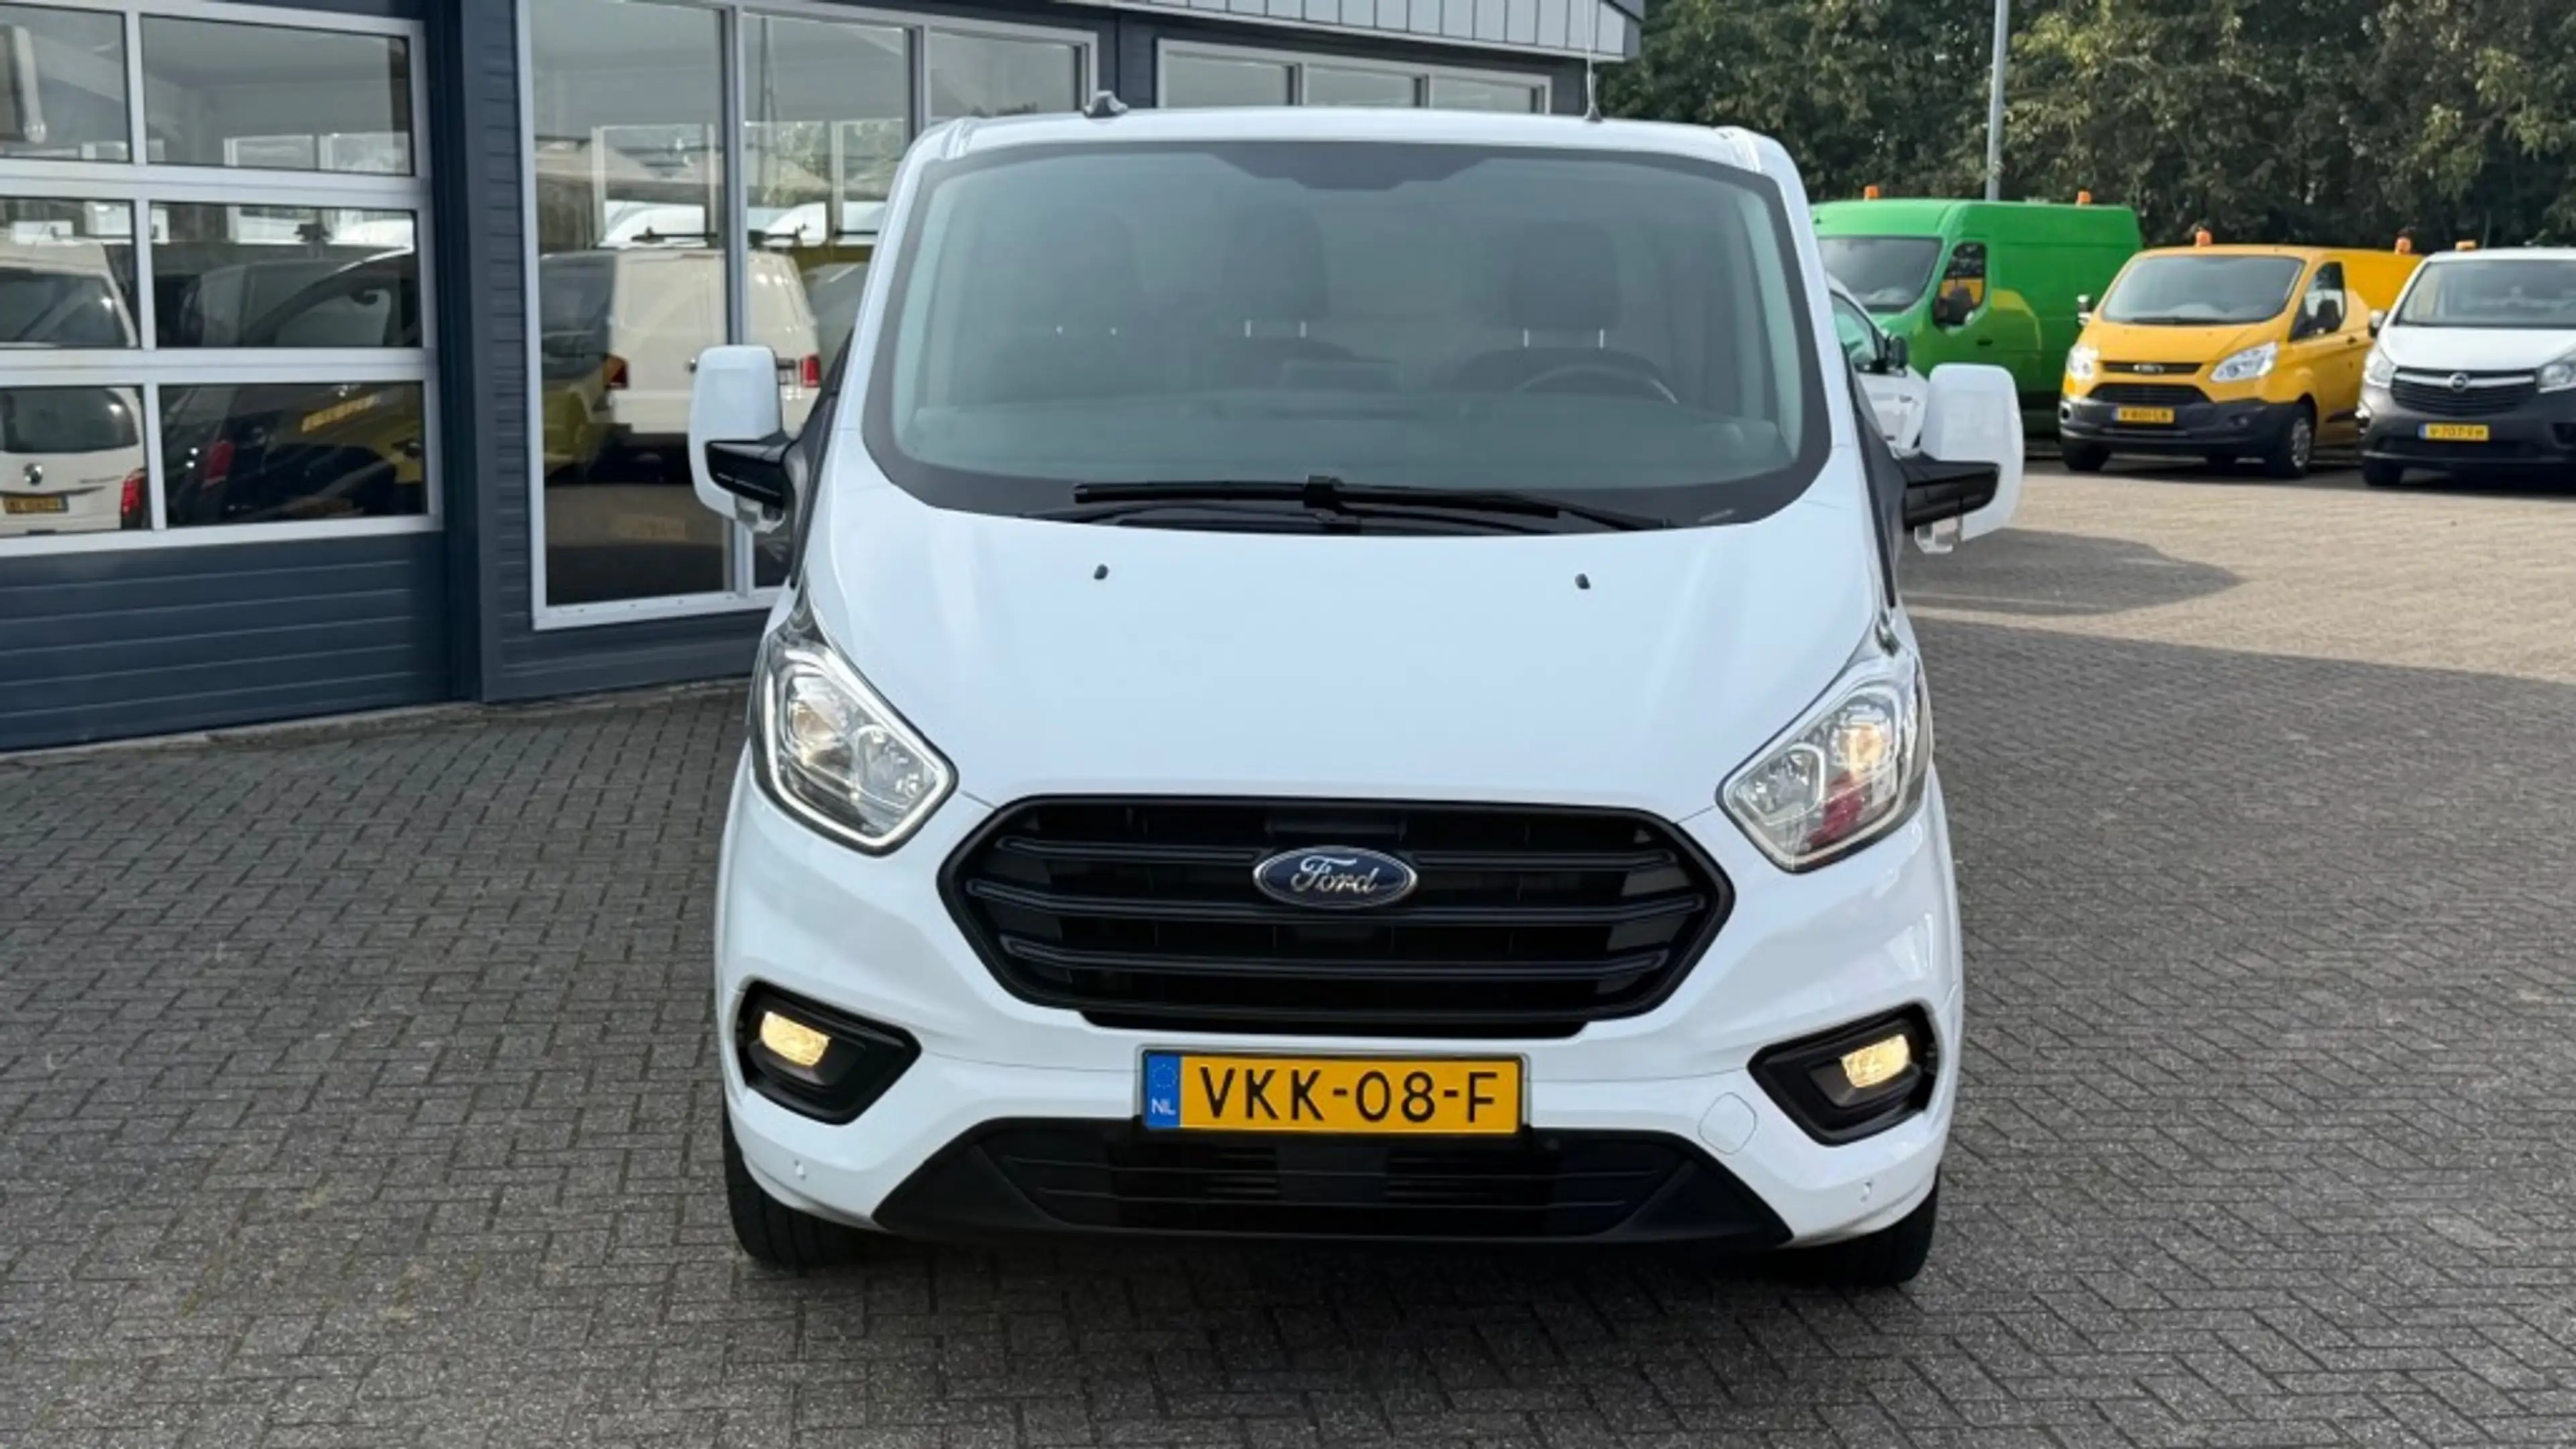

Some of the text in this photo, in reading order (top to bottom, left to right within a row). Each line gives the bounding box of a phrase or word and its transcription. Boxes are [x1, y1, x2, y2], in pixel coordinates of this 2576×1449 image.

[1291, 855, 1379, 894] Ford
[1151, 1097, 1177, 1115] NL
[1199, 1066, 1498, 1123] VKK-08-F
